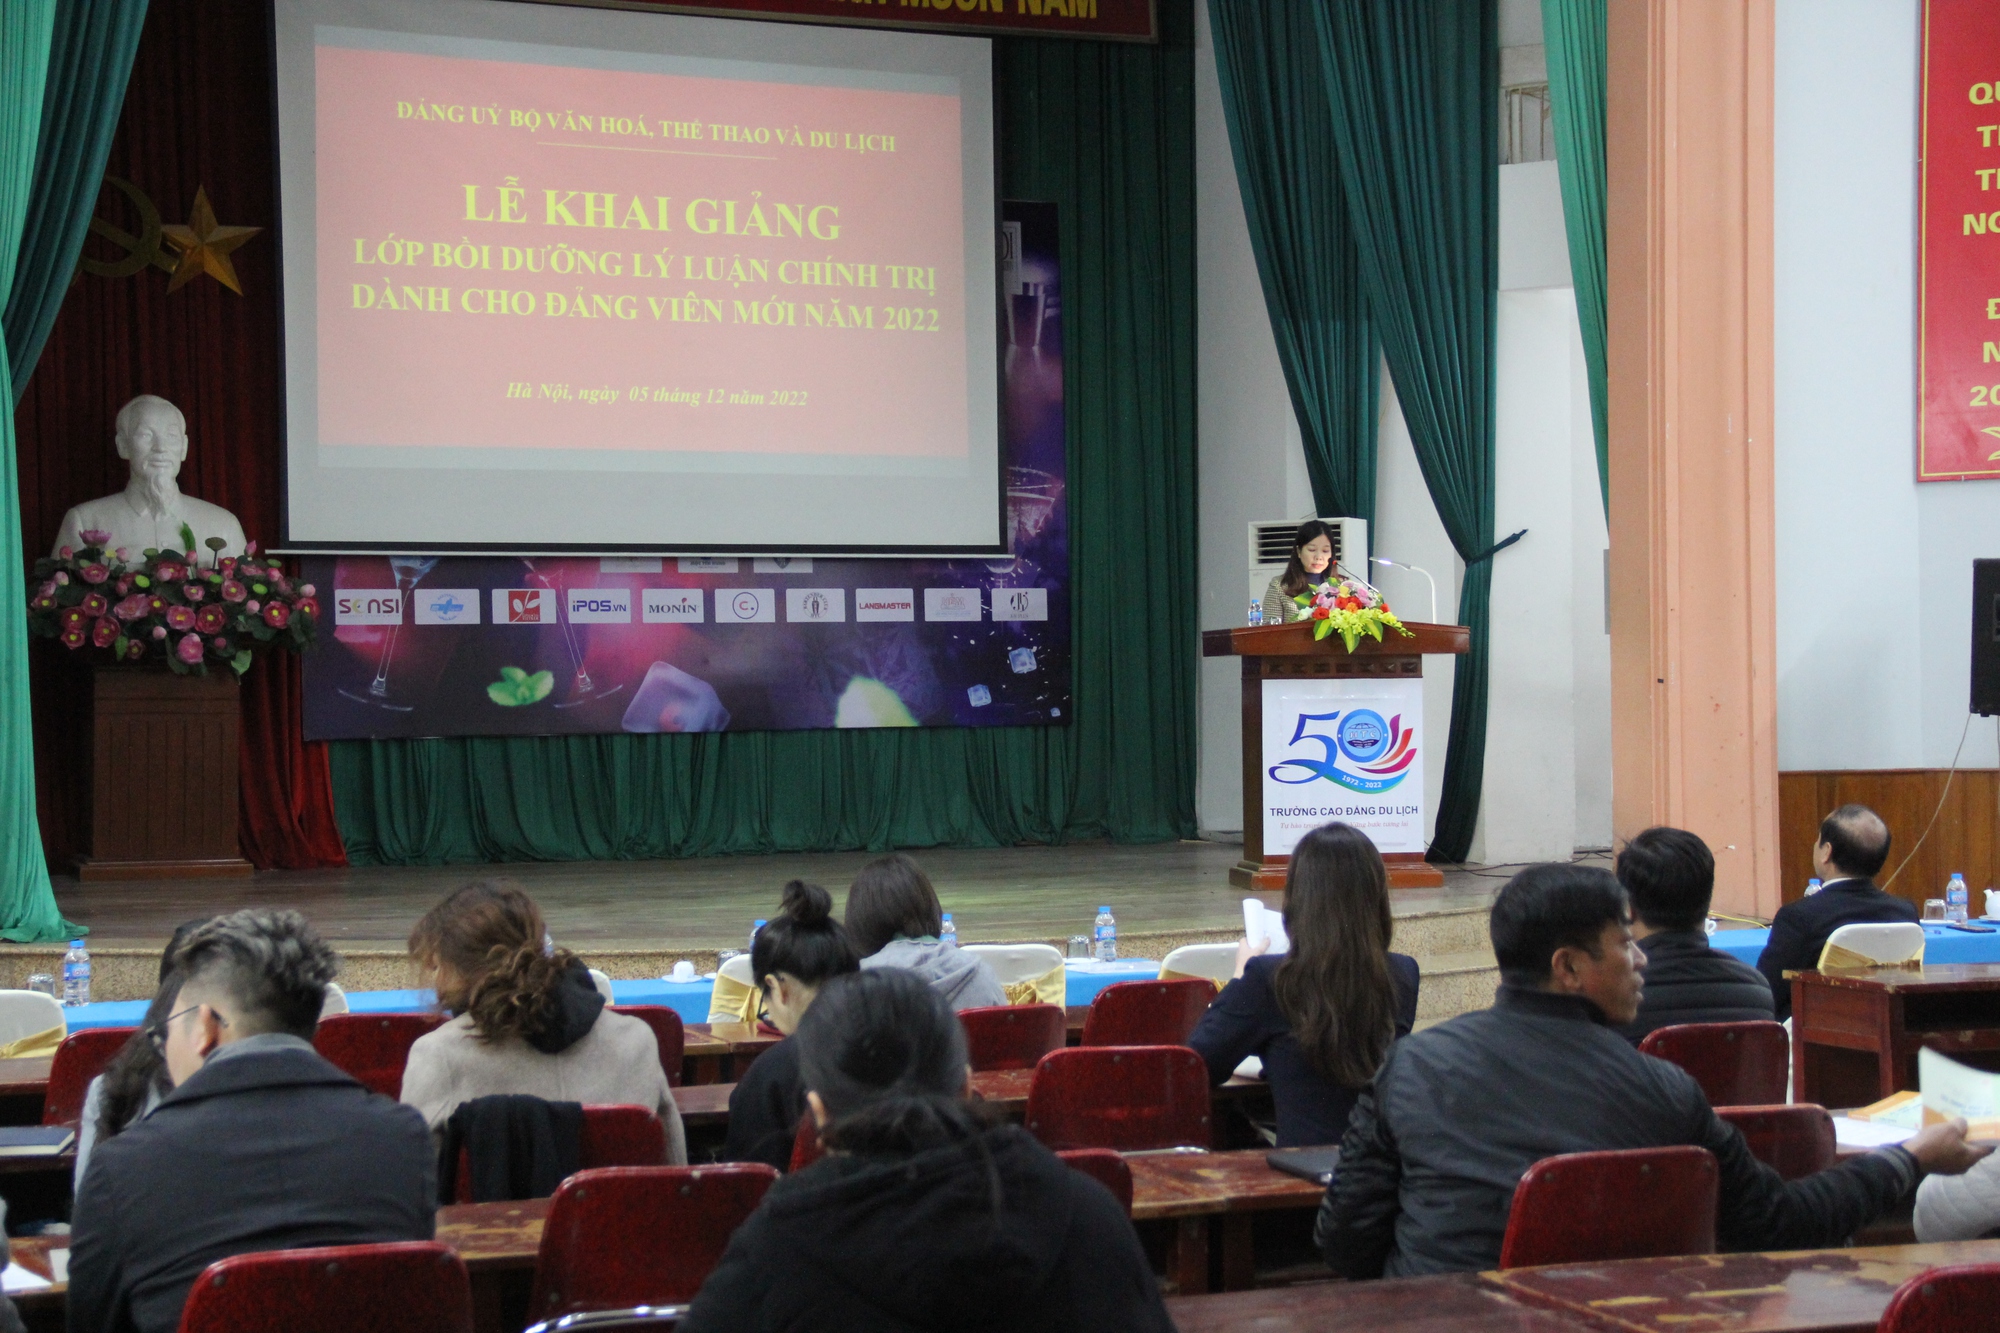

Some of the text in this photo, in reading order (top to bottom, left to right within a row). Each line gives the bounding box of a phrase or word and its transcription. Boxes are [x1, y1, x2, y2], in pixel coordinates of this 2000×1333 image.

[1968, 82, 2000, 105] Q
[397, 98, 465, 123] ĐẢNG
[509, 108, 541, 132] BỘ
[546, 110, 593, 131] VĂN
[600, 114, 654, 138] HOÁ,
[658, 118, 703, 140] THỂ
[708, 124, 770, 144] THAO
[775, 125, 804, 146] VÀ
[809, 131, 838, 148] DU
[844, 133, 896, 154] LỊCH
[1976, 125, 2000, 148] T
[1975, 168, 2000, 191] T
[462, 175, 841, 240] LỄ KHAI GIẢNG
[354, 233, 937, 297] LỚP BỒI DƯỠNG LÝ LUẬN CHÍNH TRỊ
[351, 277, 940, 332] DÀNH CHO ĐẢNG VIÊN MỚI NĂM 2022
[506, 382, 808, 407] Hà Nội, ngày 05 tháng 12 năm 2022
[859, 601, 911, 610] LANGMASTER
[1342, 774, 1359, 786] 1972
[1320, 806, 1343, 816] CAO
[1378, 806, 1393, 815] DU
[1396, 805, 1418, 817] LỊCH
